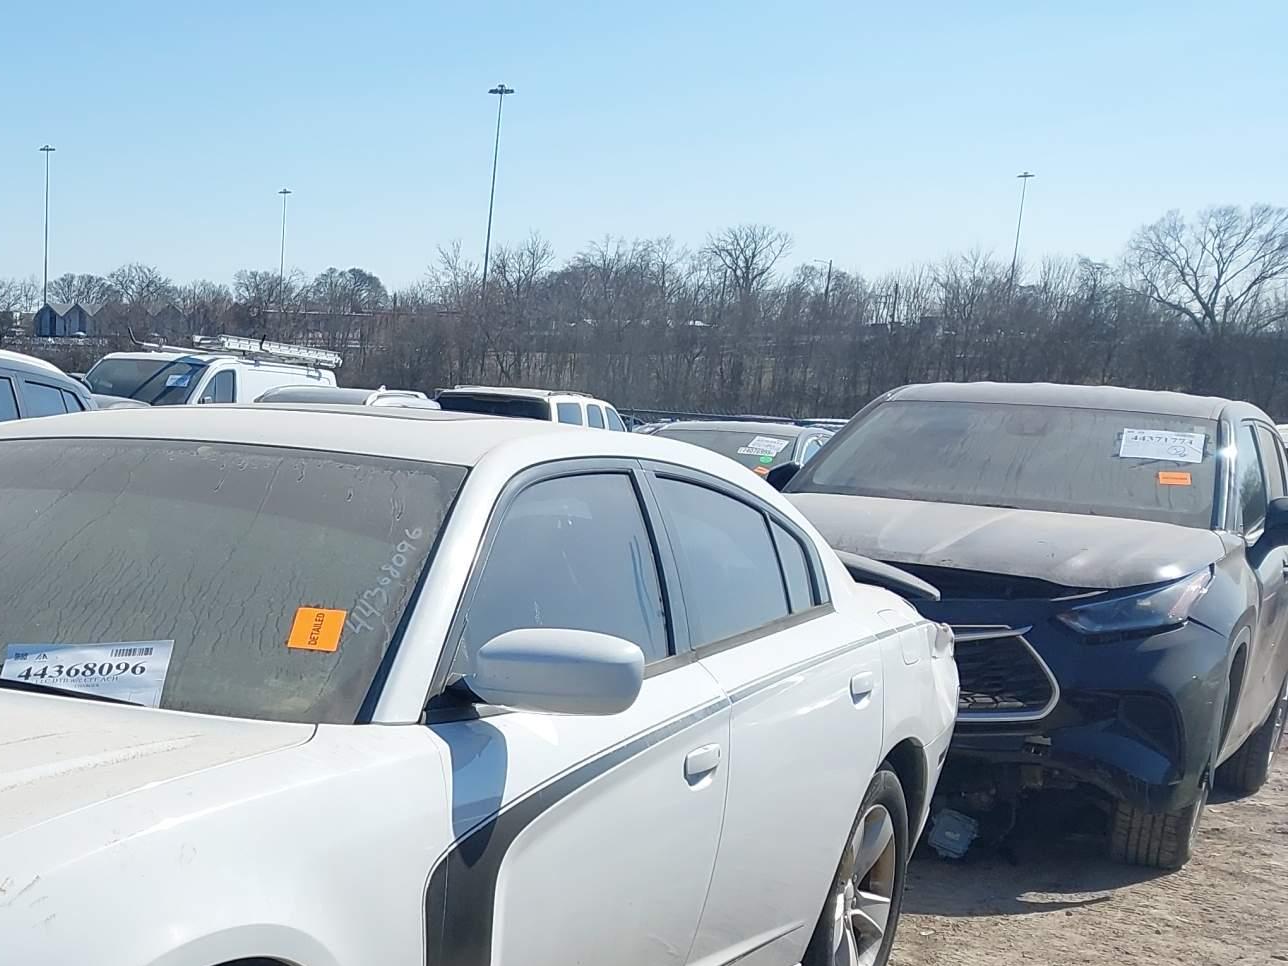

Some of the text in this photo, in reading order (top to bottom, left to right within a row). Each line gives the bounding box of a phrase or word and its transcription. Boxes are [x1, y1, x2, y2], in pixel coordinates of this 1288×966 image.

[346, 527, 423, 634] 44368096
[308, 612, 326, 646] DETAILED
[17, 661, 147, 681] 44368096
